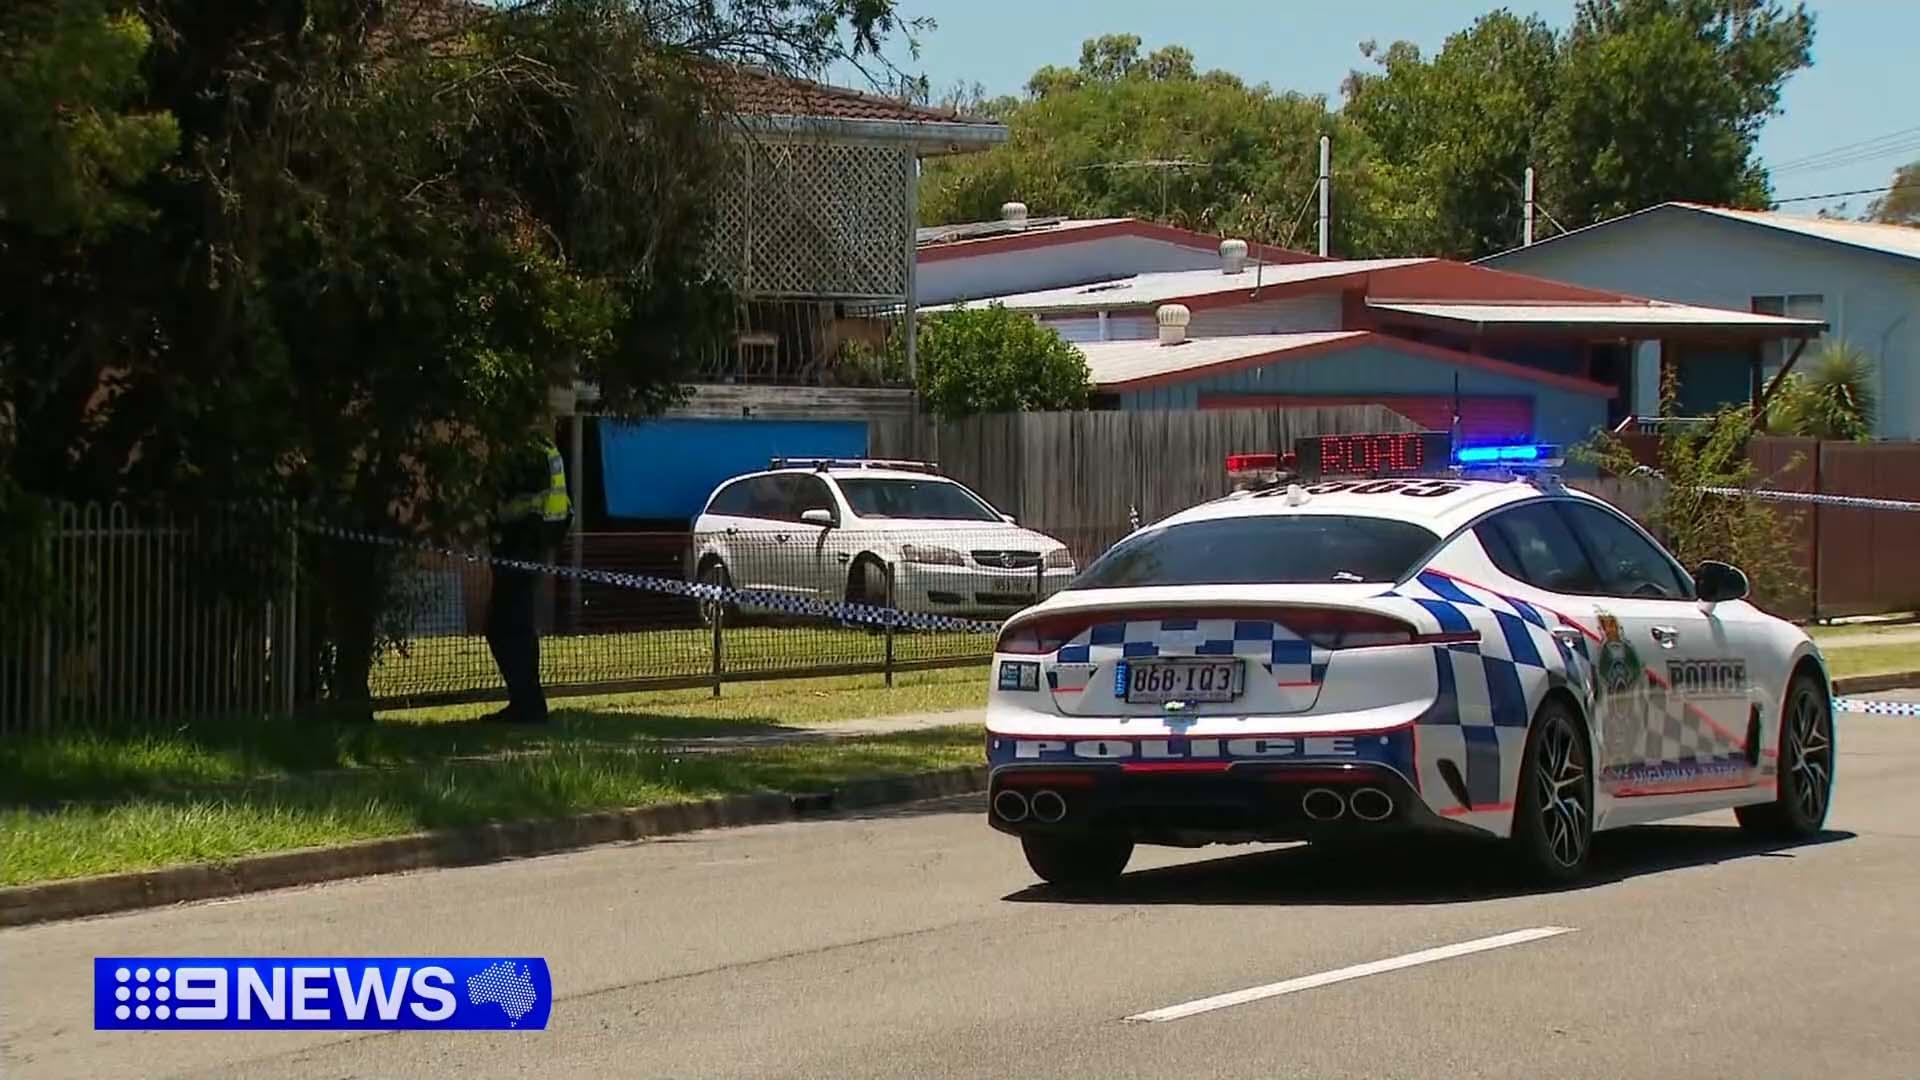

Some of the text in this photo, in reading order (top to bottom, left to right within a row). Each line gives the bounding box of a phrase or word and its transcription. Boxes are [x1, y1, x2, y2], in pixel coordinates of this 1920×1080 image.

[1321, 435, 1424, 473] ROAD
[1666, 660, 1747, 694] POLICE
[1014, 738, 1358, 759] POLICE
